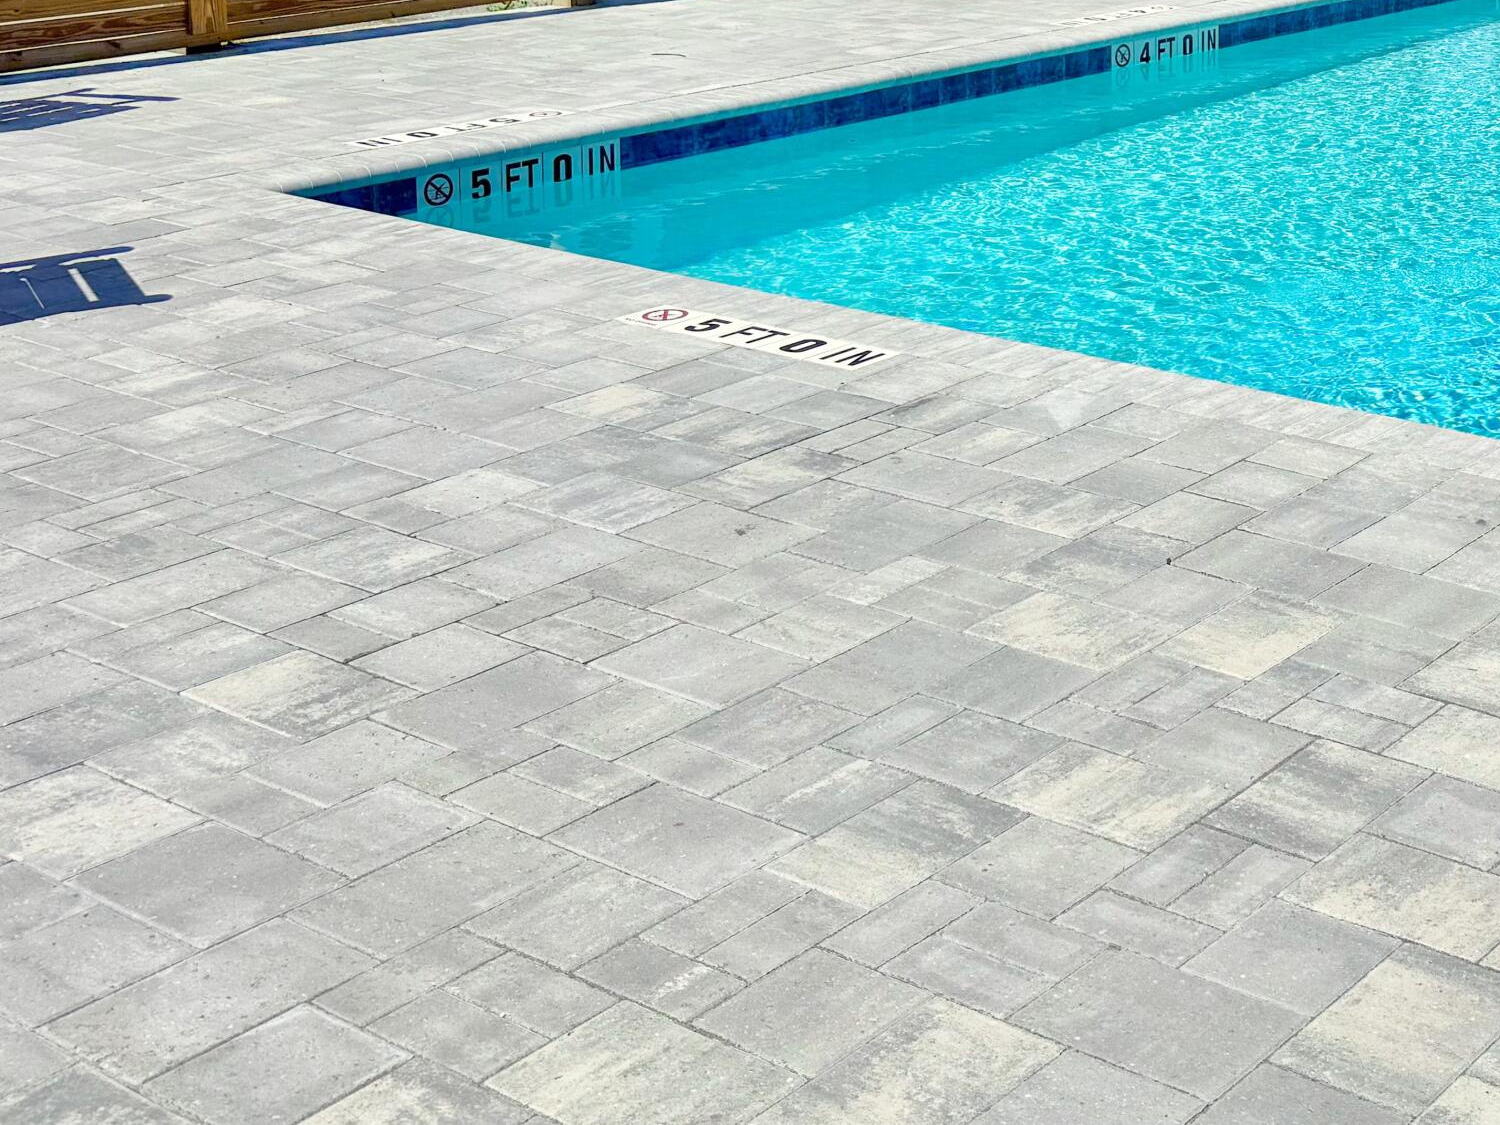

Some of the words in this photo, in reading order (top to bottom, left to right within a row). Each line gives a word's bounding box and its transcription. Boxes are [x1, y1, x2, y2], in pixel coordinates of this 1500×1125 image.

[1140, 42, 1151, 64] 4
[1157, 36, 1176, 61] FT
[1182, 34, 1194, 56] 0
[1201, 28, 1217, 52] IN
[355, 137, 401, 147] IN
[445, 123, 486, 132] FT
[471, 168, 492, 199] 5
[505, 158, 539, 193] FT
[553, 153, 572, 183] 0
[588, 143, 615, 176] IN
[684, 318, 733, 332] 5
[719, 326, 790, 344] FT
[779, 338, 828, 352] 0
[820, 347, 886, 367] IN
